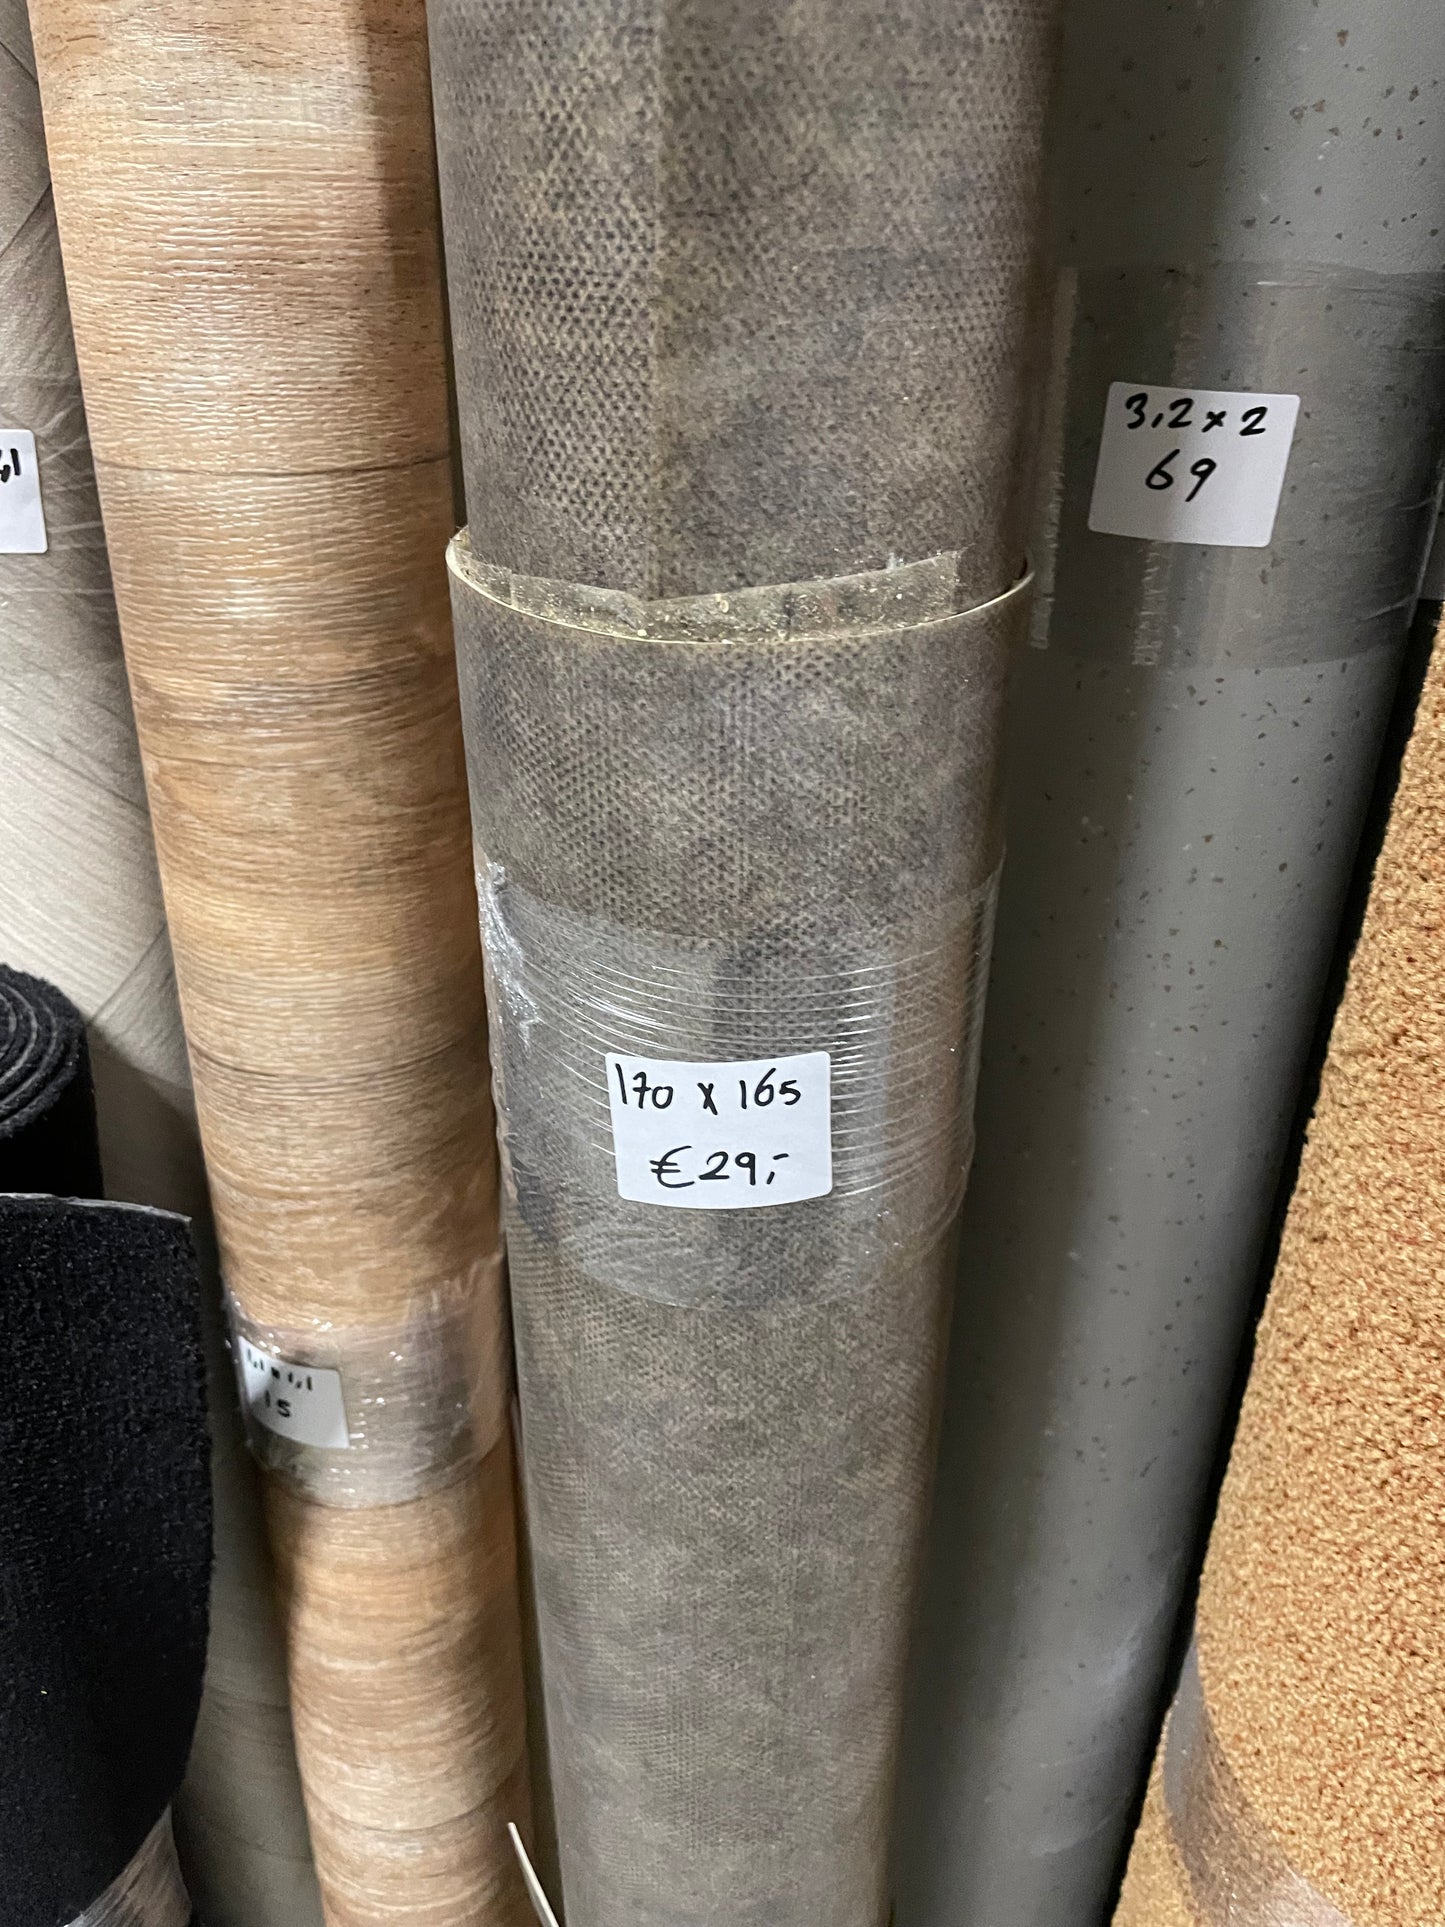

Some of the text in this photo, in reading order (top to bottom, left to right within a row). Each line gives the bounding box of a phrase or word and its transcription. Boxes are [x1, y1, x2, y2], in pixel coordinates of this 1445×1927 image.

[1125, 392, 1194, 429] 3,2
[1239, 406, 1268, 437] 2
[1145, 448, 1217, 503] 69
[615, 1063, 674, 1110] 170
[739, 1067, 802, 1110] 165
